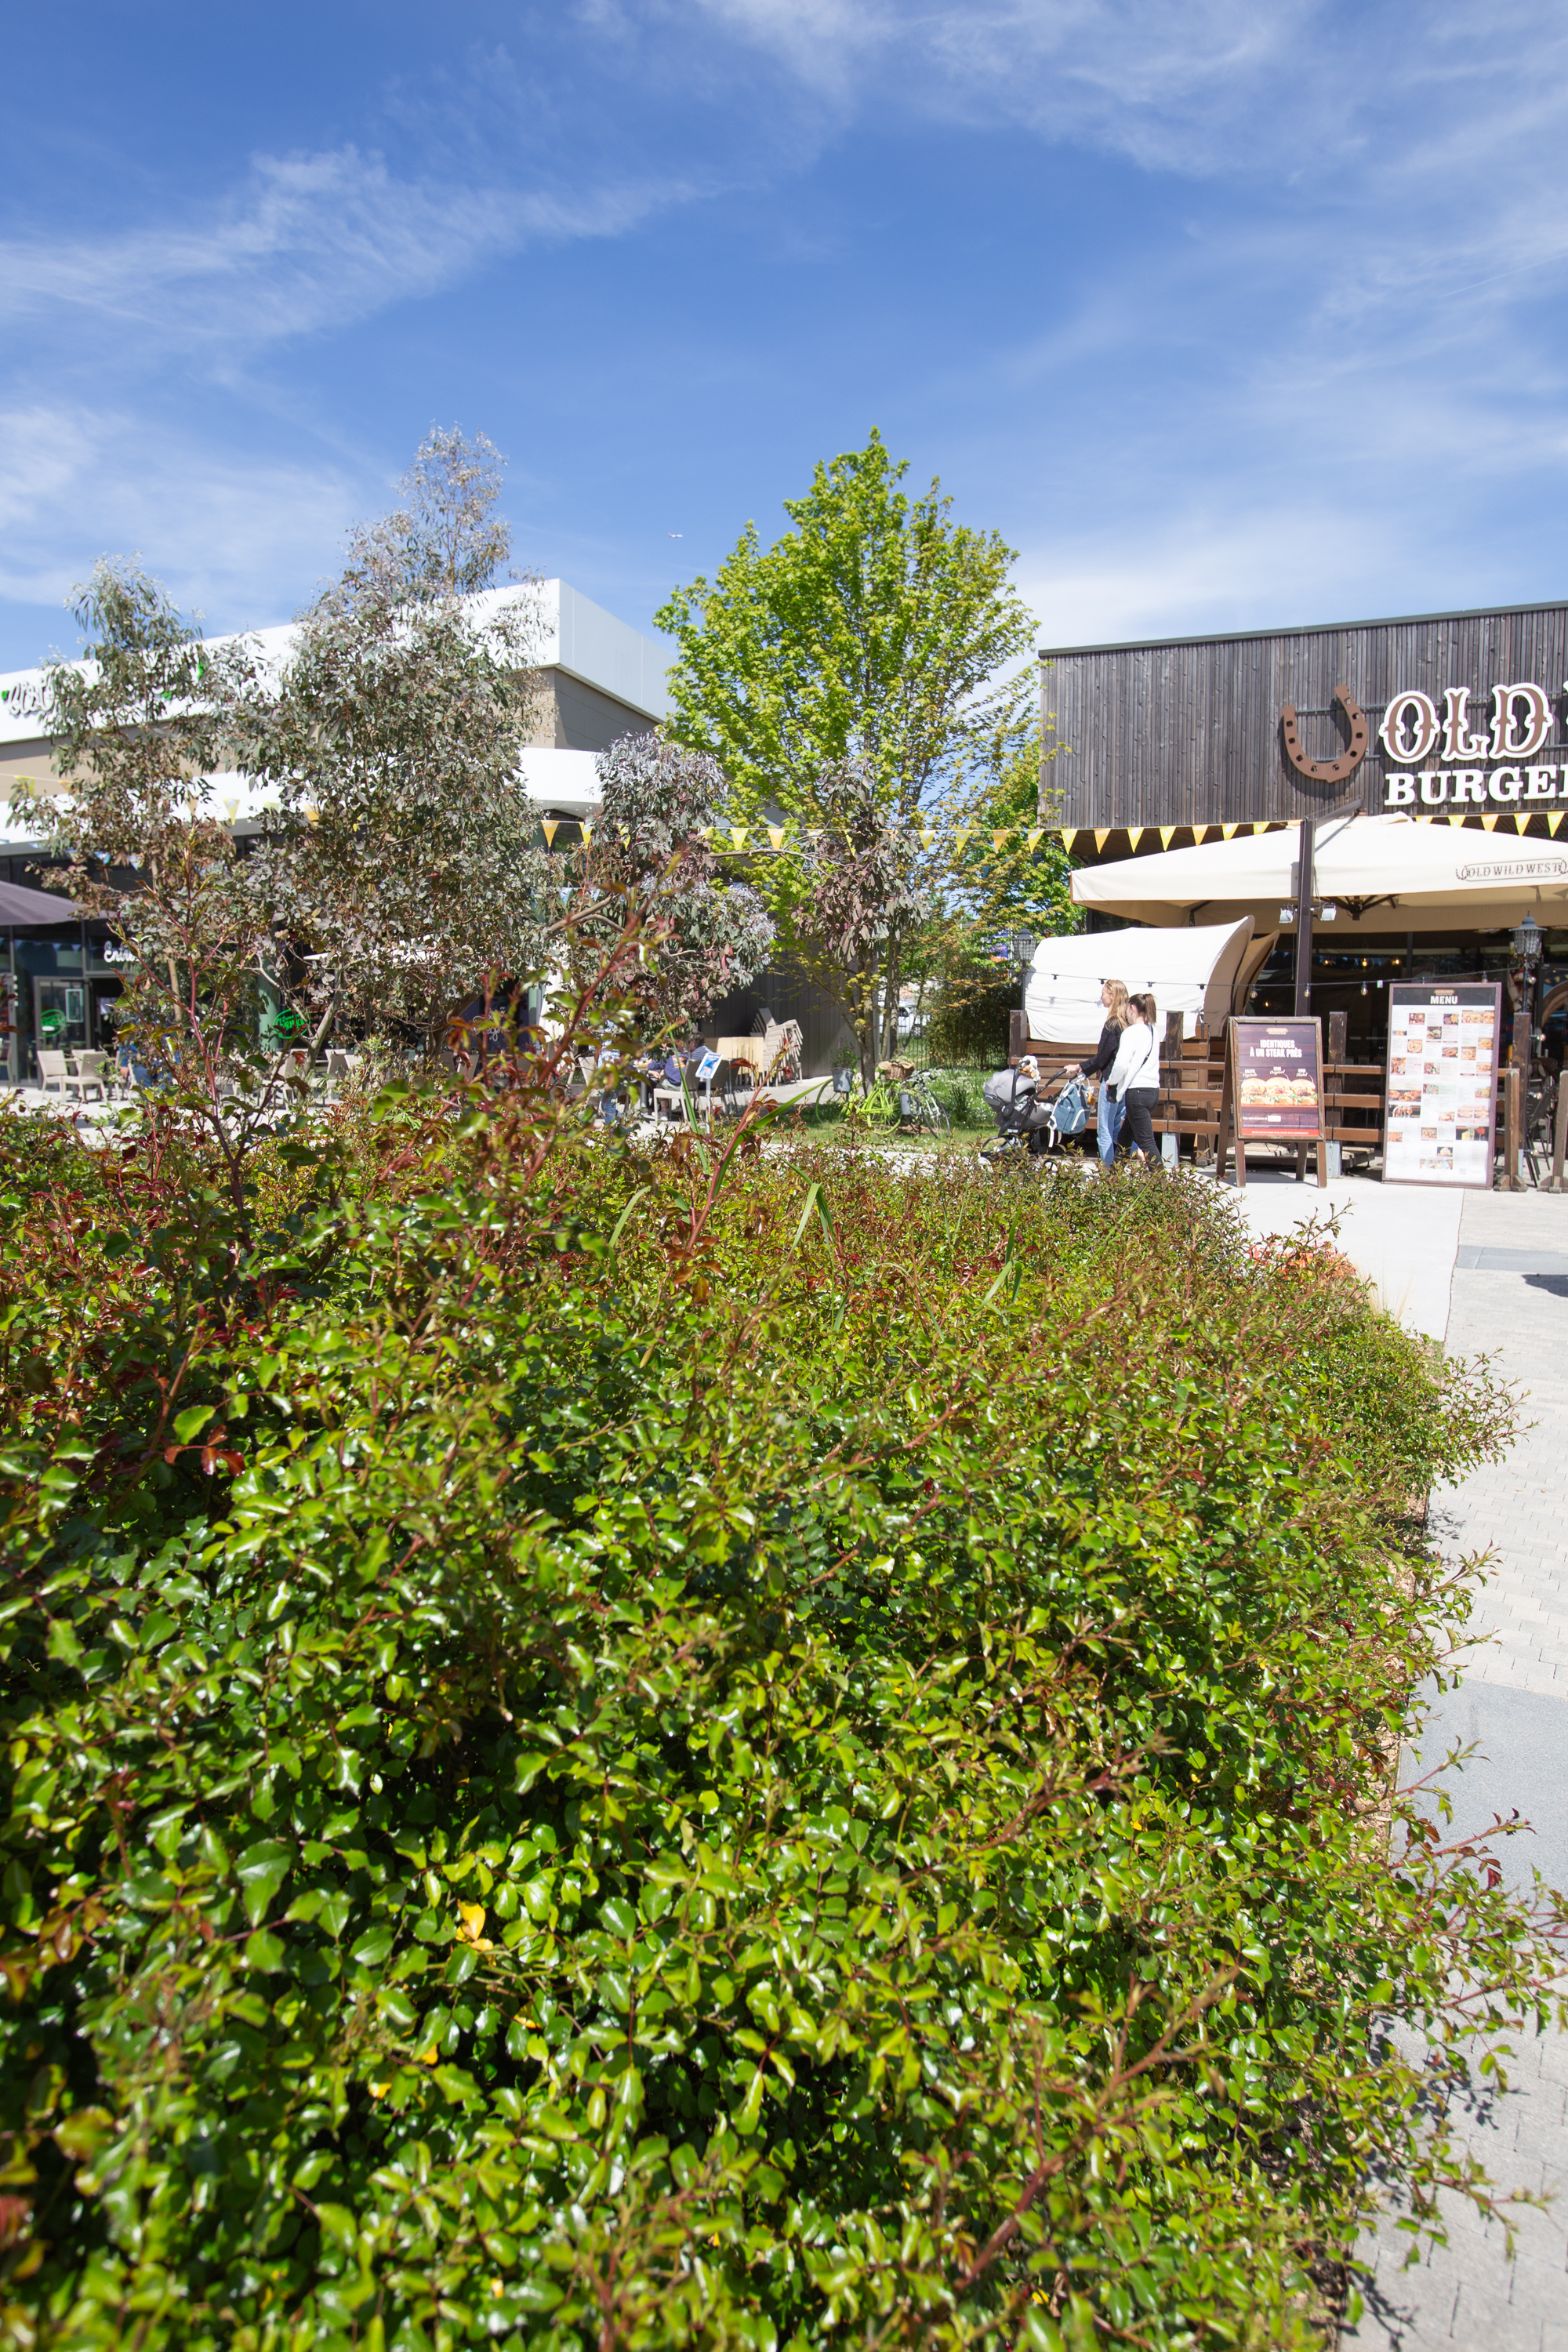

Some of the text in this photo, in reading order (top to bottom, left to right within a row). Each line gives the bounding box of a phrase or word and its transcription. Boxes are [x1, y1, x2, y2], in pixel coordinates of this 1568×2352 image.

[1378, 682, 1554, 764] OLD
[1384, 764, 1568, 806] BURGE
[1468, 862, 1562, 877] OLD WILD WEST
[1430, 996, 1458, 1004] MENU
[1260, 1040, 1295, 1048] IDENTIQUES
[1250, 1047, 1302, 1058] À UN STEAK PRÈS
